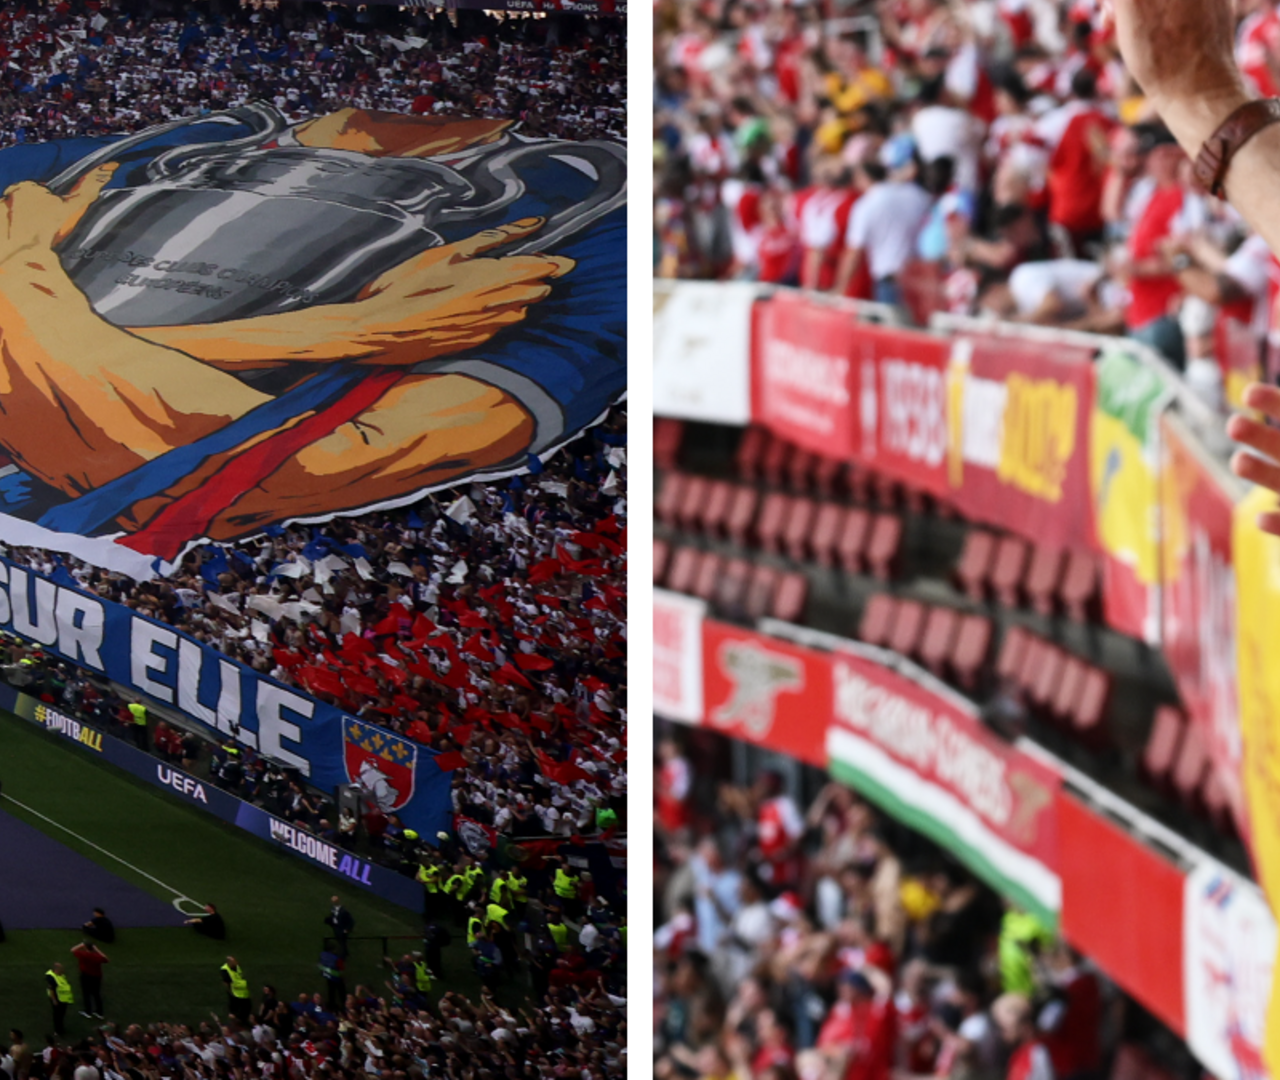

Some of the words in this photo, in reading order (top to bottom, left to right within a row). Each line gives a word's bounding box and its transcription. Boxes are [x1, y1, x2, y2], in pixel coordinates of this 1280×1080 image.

[507, 0, 534, 9] UEFA
[130, 616, 315, 778] ELLE
[34, 704, 103, 753] #FOOTBALL
[157, 764, 208, 804] UEFA
[269, 817, 338, 870] WELCOME
[338, 854, 372, 886] ALL
